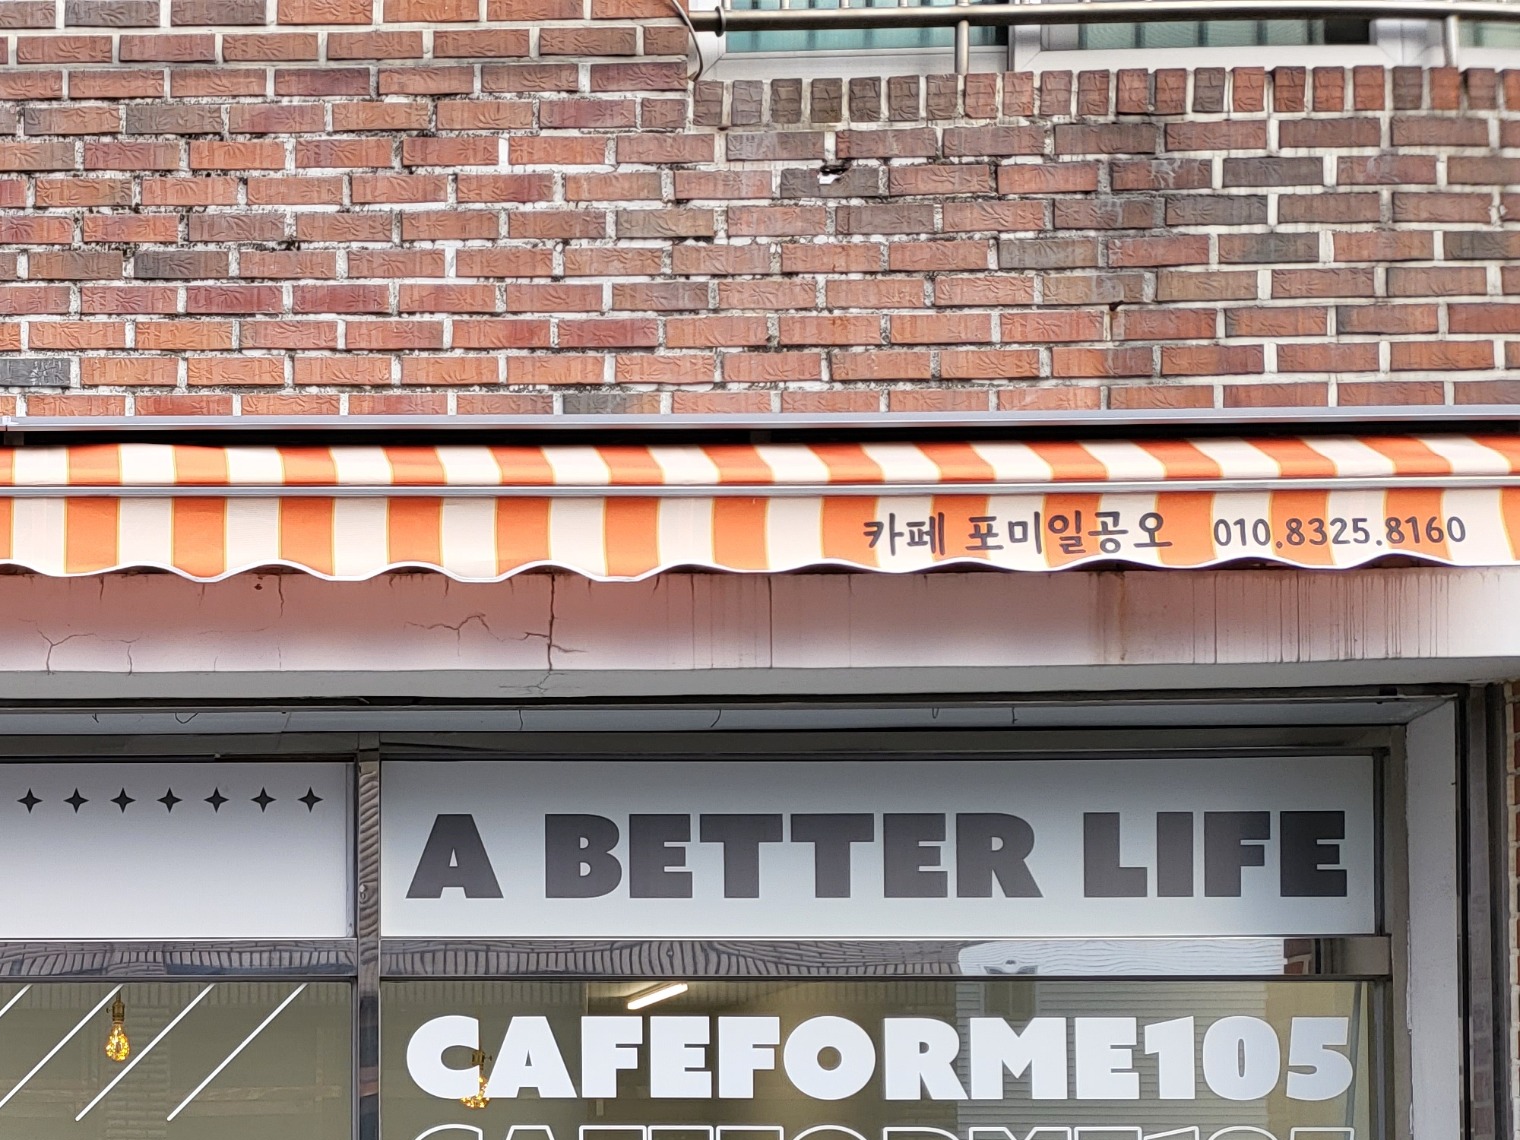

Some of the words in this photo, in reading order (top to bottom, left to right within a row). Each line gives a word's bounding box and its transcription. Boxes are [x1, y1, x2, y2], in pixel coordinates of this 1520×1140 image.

[863, 511, 945, 556] 카페
[965, 510, 1173, 554] 포미일공오
[1213, 516, 1466, 549] 010.8325.8160
[405, 813, 503, 899] A
[544, 812, 1042, 899] BETTER
[1083, 810, 1348, 898] LIFE
[405, 1015, 1353, 1102] CAFEFORME105
